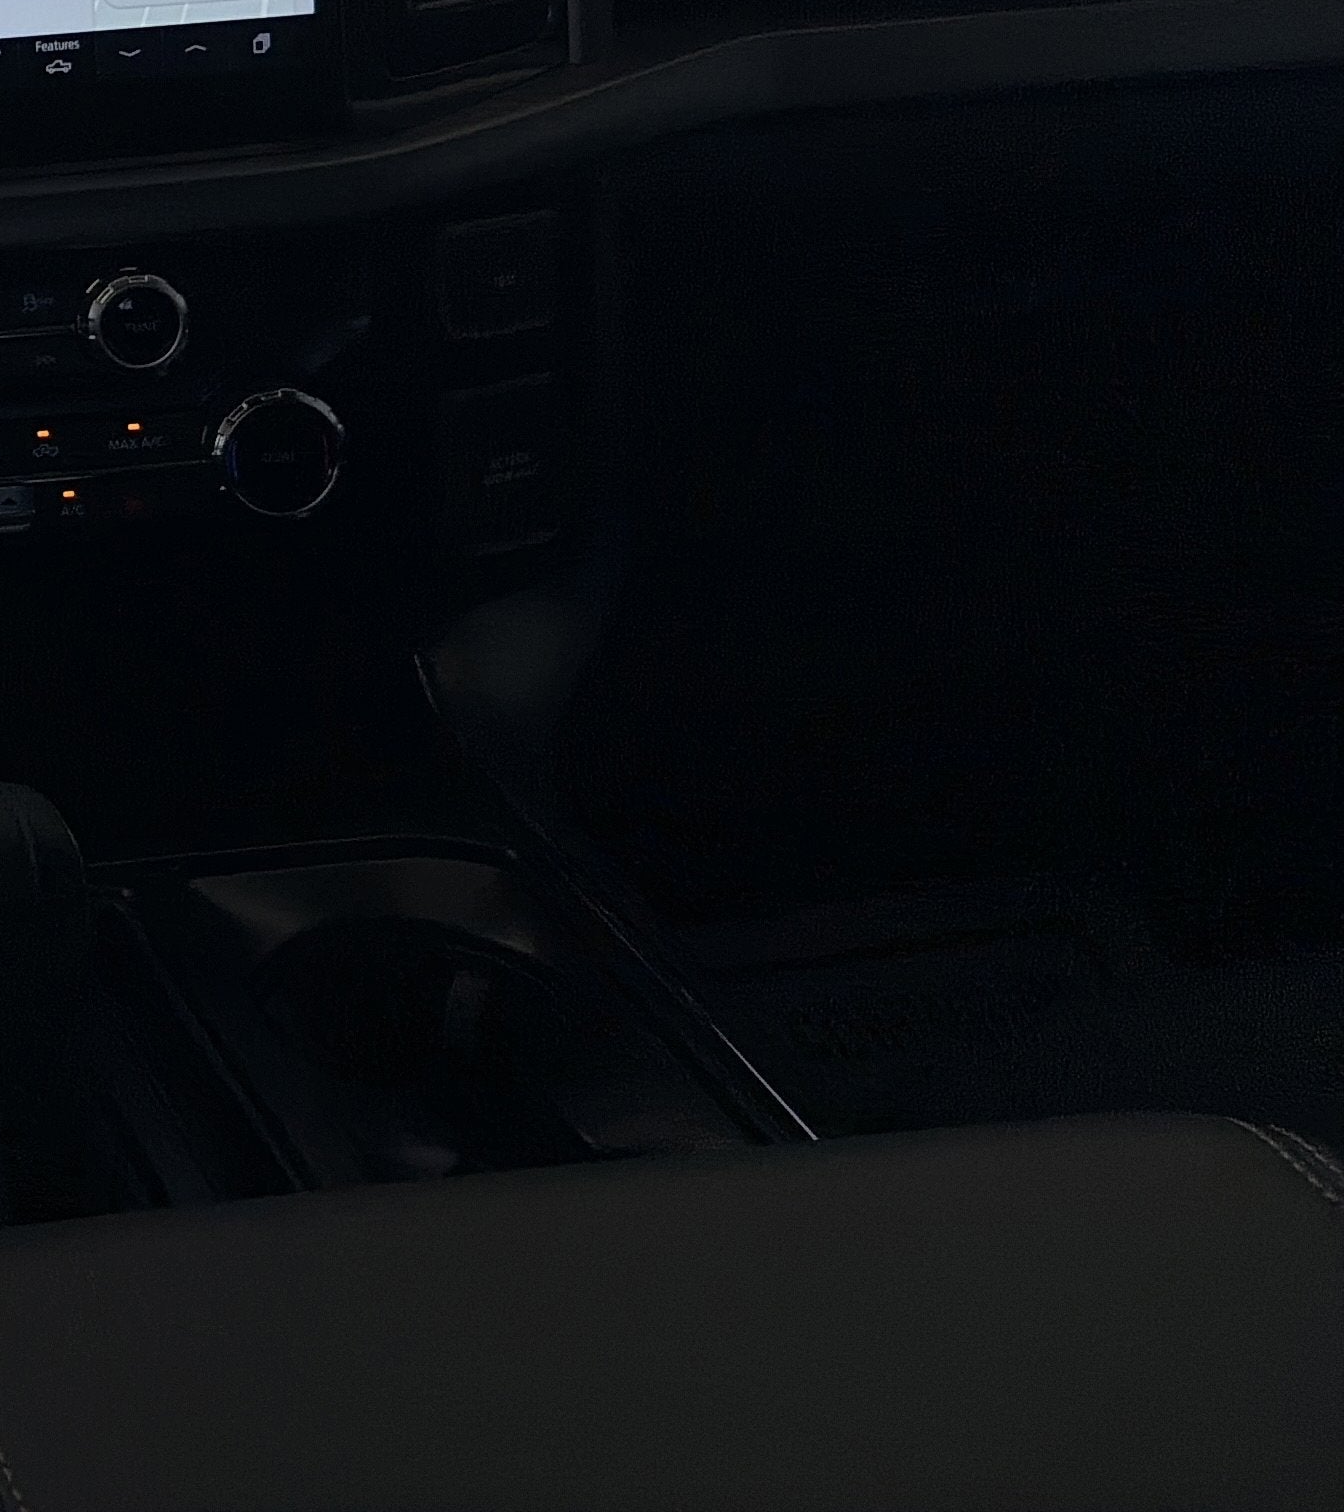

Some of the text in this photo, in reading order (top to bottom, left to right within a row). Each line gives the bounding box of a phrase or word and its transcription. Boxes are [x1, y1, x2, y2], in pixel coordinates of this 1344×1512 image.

[35, 38, 80, 53] Features
[109, 439, 138, 451] MAX
[60, 503, 85, 517] A/C
